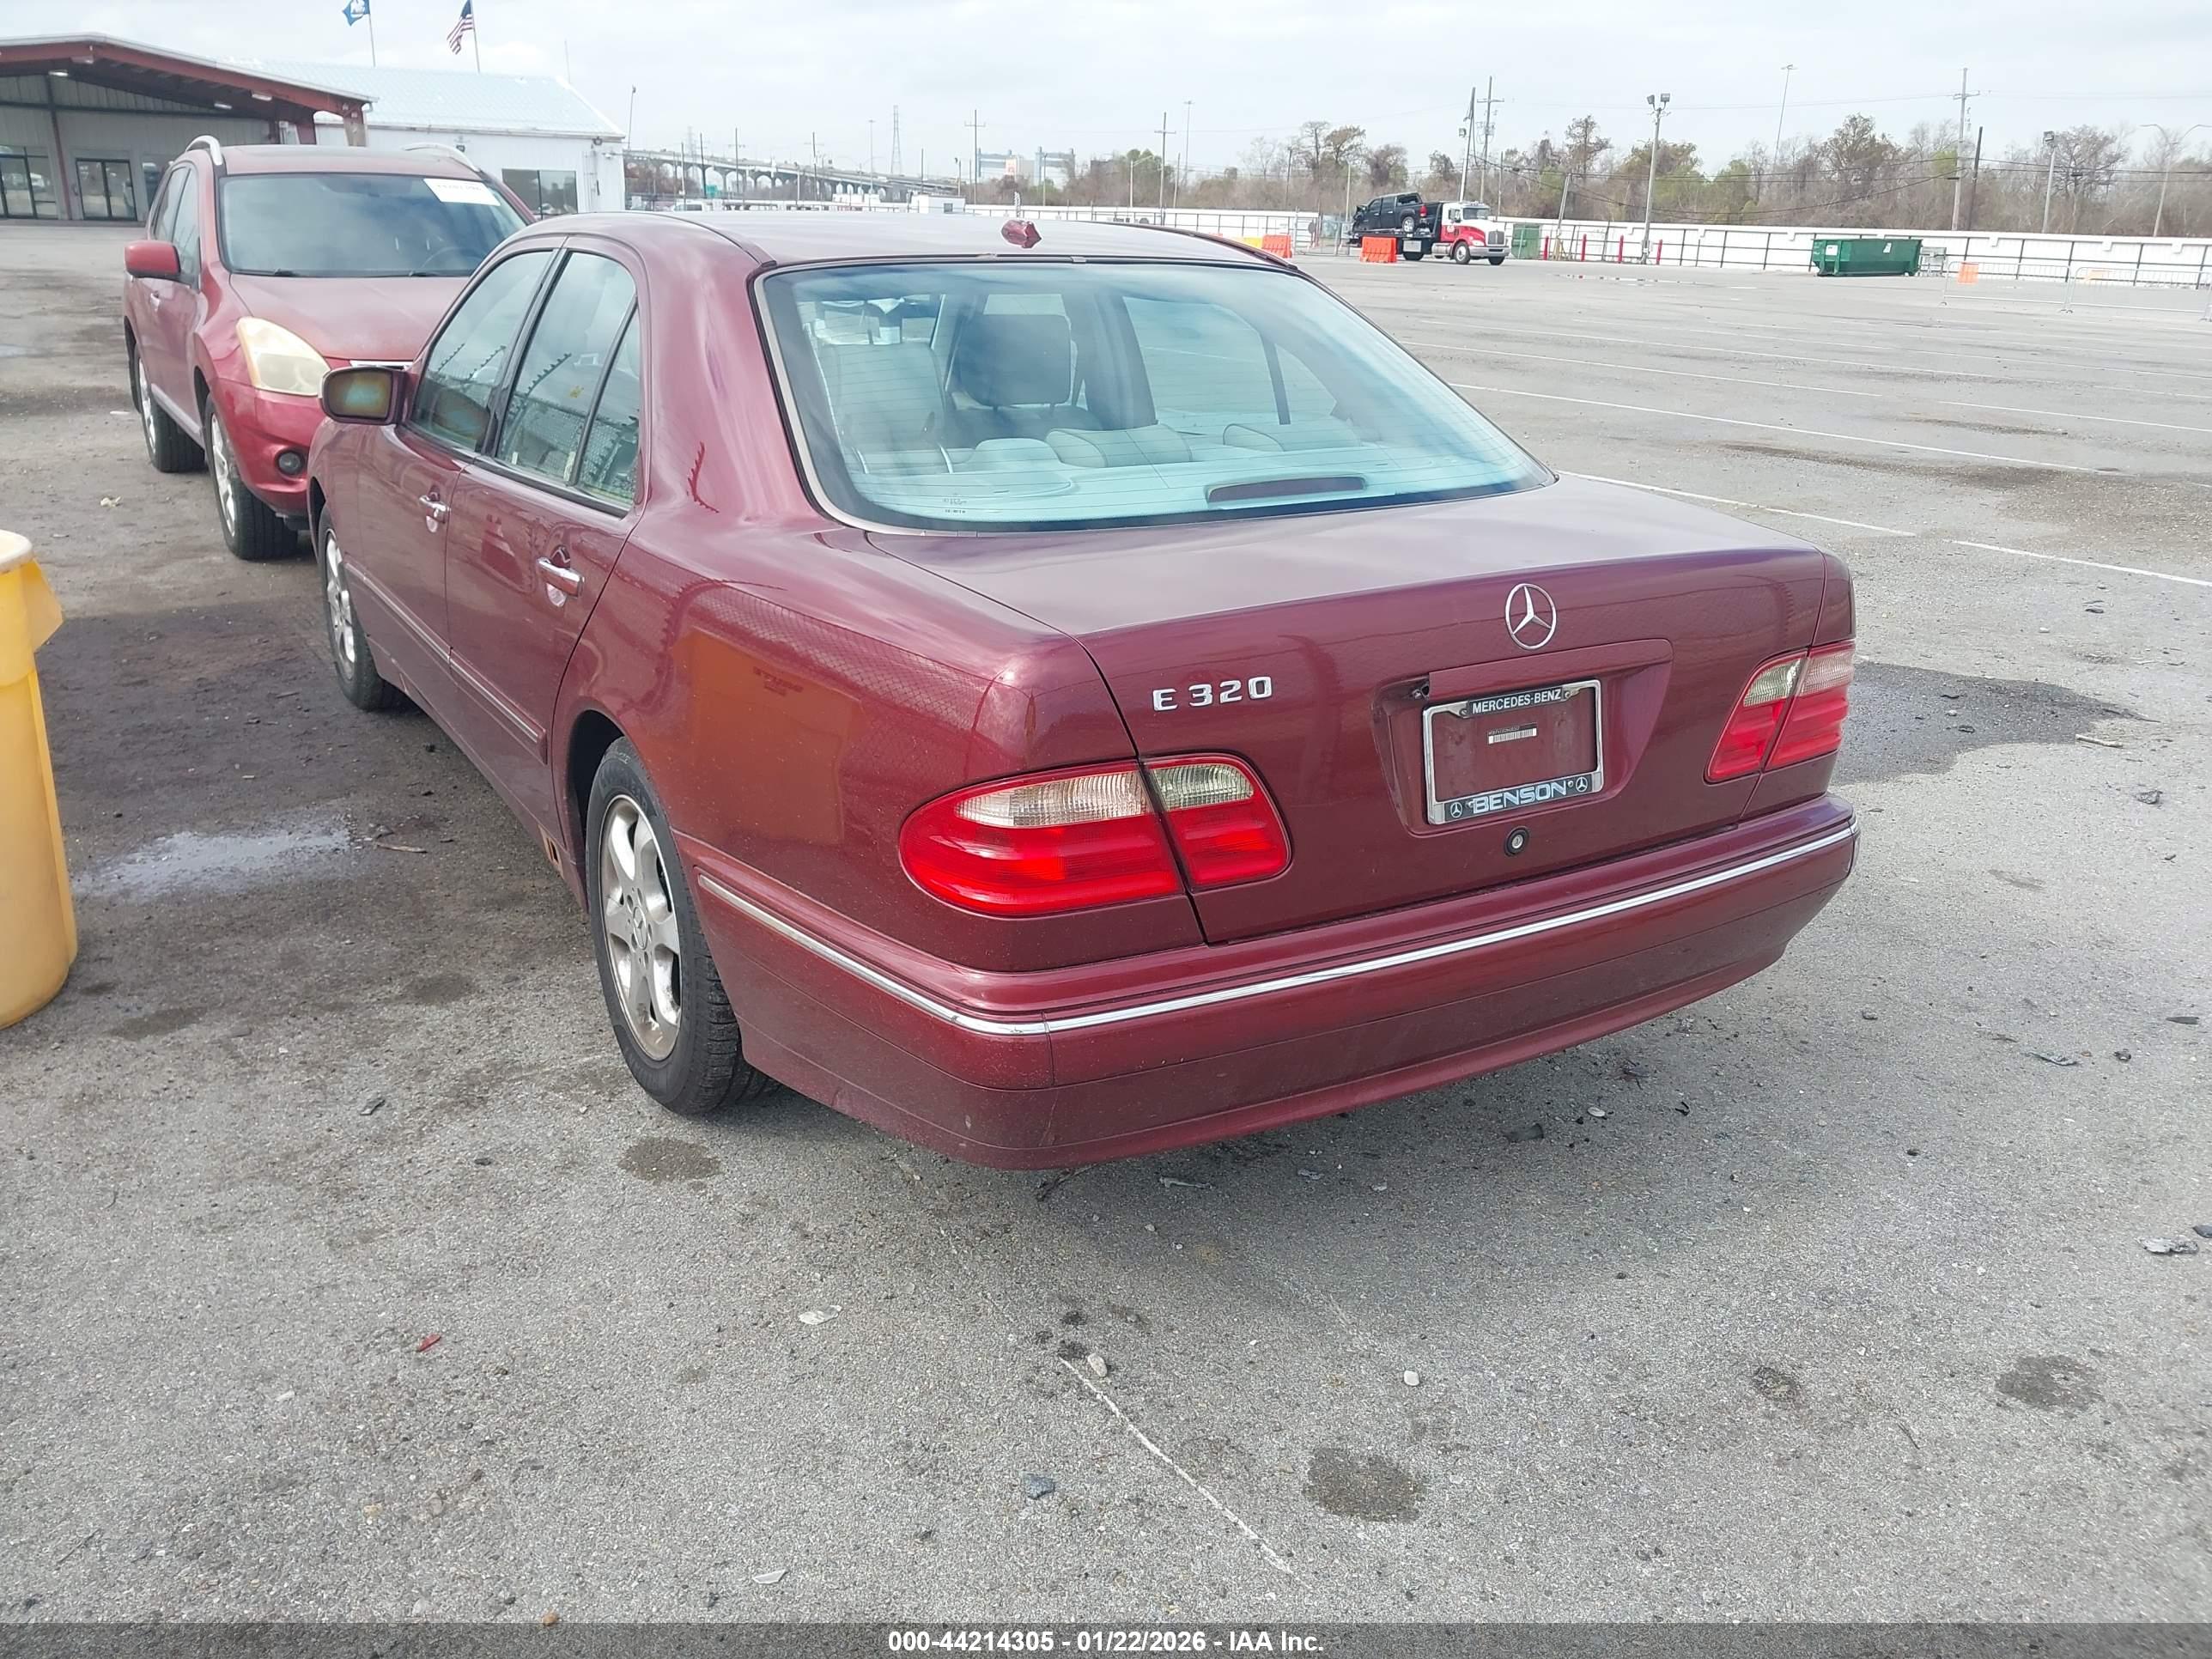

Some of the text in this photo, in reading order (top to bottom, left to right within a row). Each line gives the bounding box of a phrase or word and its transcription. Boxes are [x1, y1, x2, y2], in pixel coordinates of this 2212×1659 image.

[1152, 677, 1273, 711] E 320
[1472, 689, 1561, 714] MERCEDES-BENZ
[1472, 780, 1568, 814] BENSON
